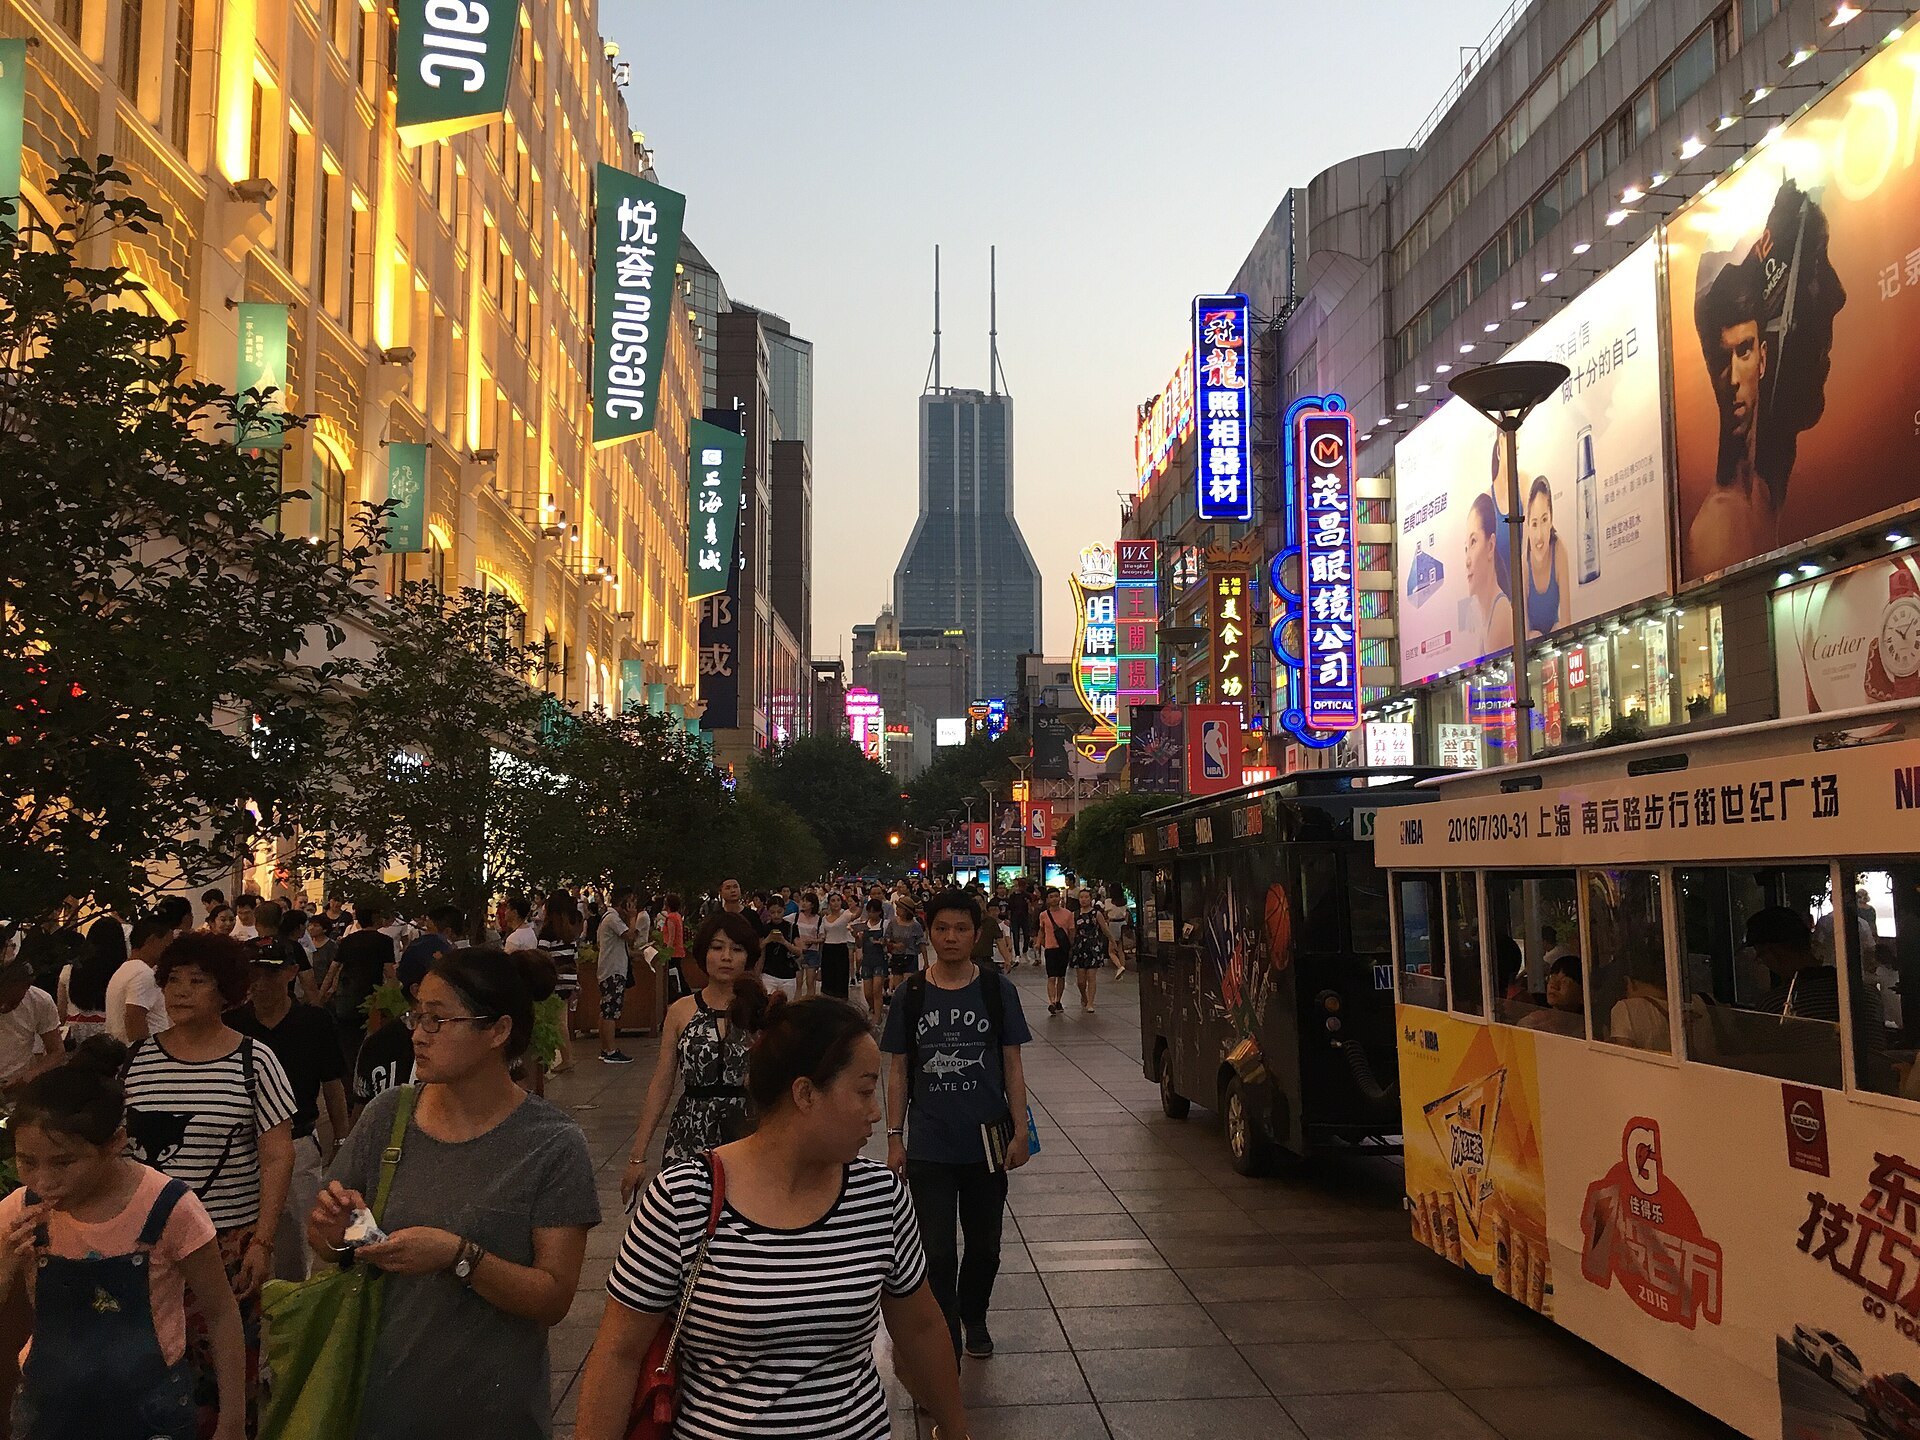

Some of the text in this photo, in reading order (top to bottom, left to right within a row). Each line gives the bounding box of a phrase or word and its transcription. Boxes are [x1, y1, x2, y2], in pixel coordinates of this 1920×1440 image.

[605, 291, 652, 421] mosaic
[1311, 473, 1353, 687] 茂昌眼镜公司
[1219, 598, 1243, 697] 美食广场
[1812, 634, 1866, 661] Cartier
[1569, 653, 1583, 670] UNI
[1570, 669, 1584, 687] QLO
[1313, 700, 1354, 711] OPTICAL
[1206, 766, 1222, 776] NBA
[1448, 773, 1840, 843] 2016/7/30-31 上海 南京路步行街世纪广场
[1404, 819, 1424, 845] NBA
[931, 1060, 969, 1068] SEAFOOD
[929, 1080, 978, 1092] GATE 07
[1791, 1116, 1819, 1129] NISSAN
[1626, 1125, 1660, 1196] G
[1629, 1195, 1664, 1224] 佳得乐
[1637, 1284, 1670, 1313] 2016
[1862, 1295, 1886, 1319] GO
